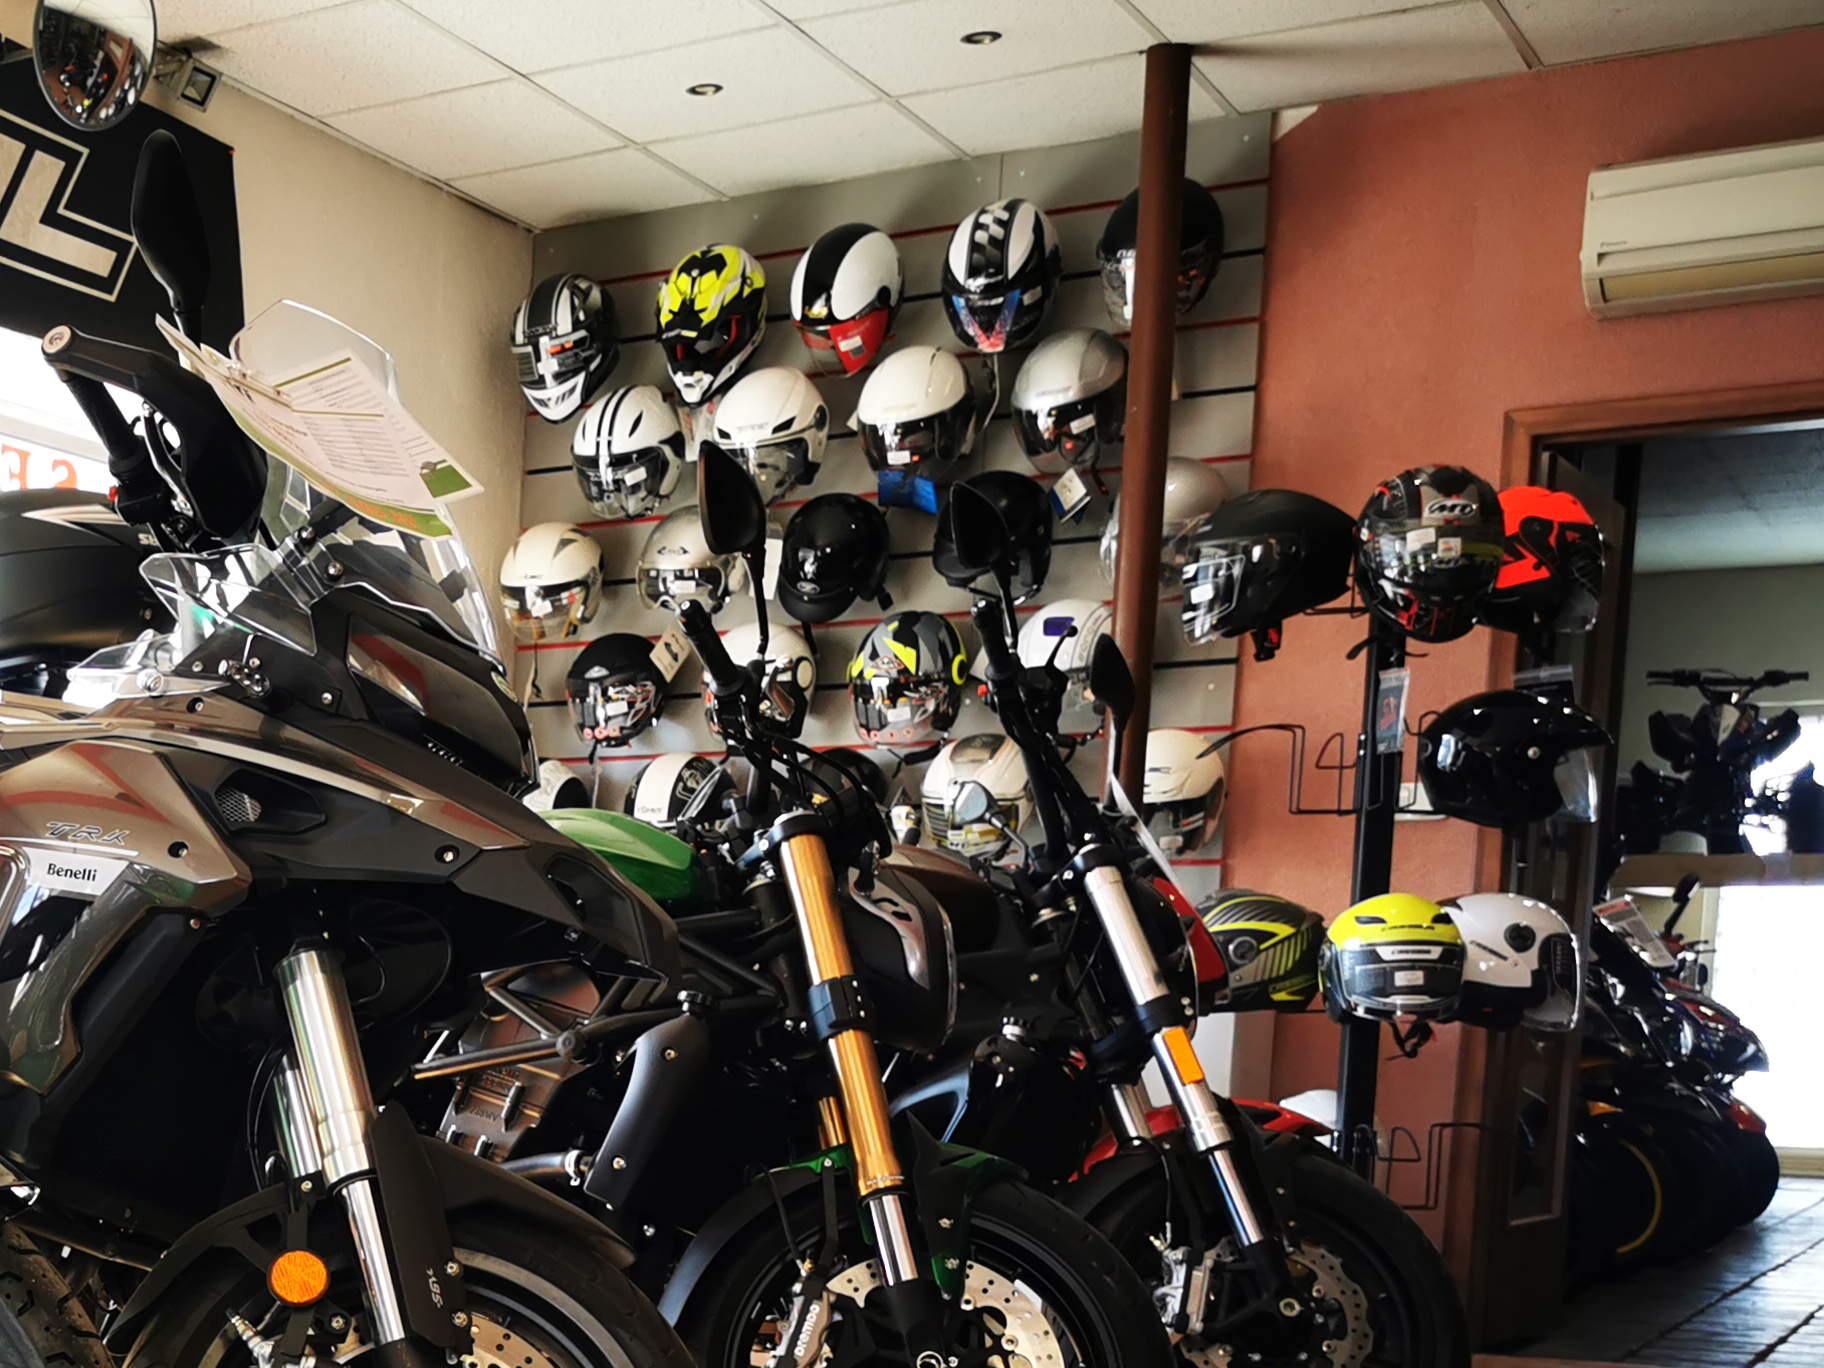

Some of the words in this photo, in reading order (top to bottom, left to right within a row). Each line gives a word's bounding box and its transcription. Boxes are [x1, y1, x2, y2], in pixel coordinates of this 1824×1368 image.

[45, 821, 130, 846] TRK
[47, 862, 98, 882] Benelli
[793, 1303, 820, 1357] brembo
